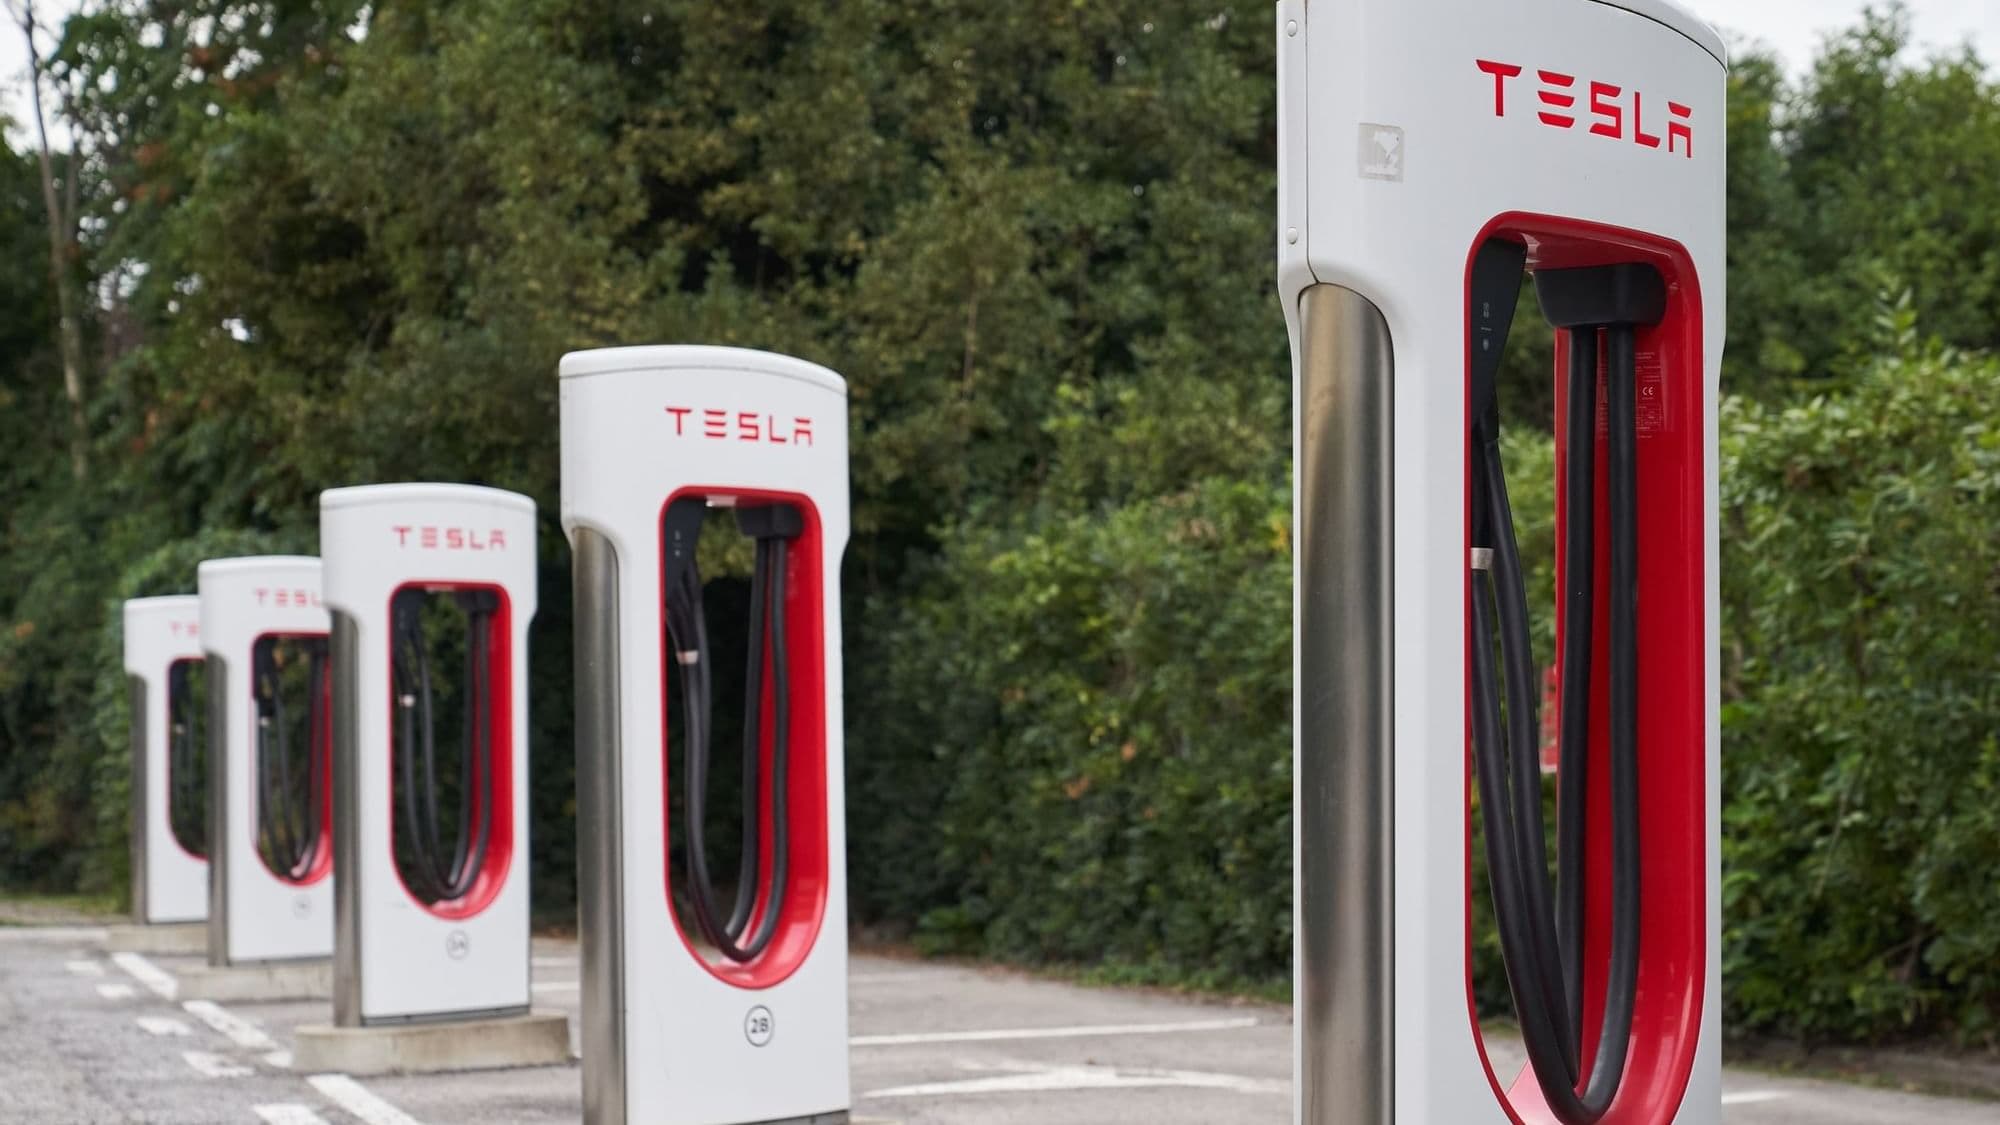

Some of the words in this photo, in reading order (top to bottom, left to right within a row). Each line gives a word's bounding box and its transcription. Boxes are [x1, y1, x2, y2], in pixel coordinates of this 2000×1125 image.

[1476, 59, 1692, 158] TESLA
[665, 407, 812, 446] TESLA
[392, 526, 505, 549] TESLA
